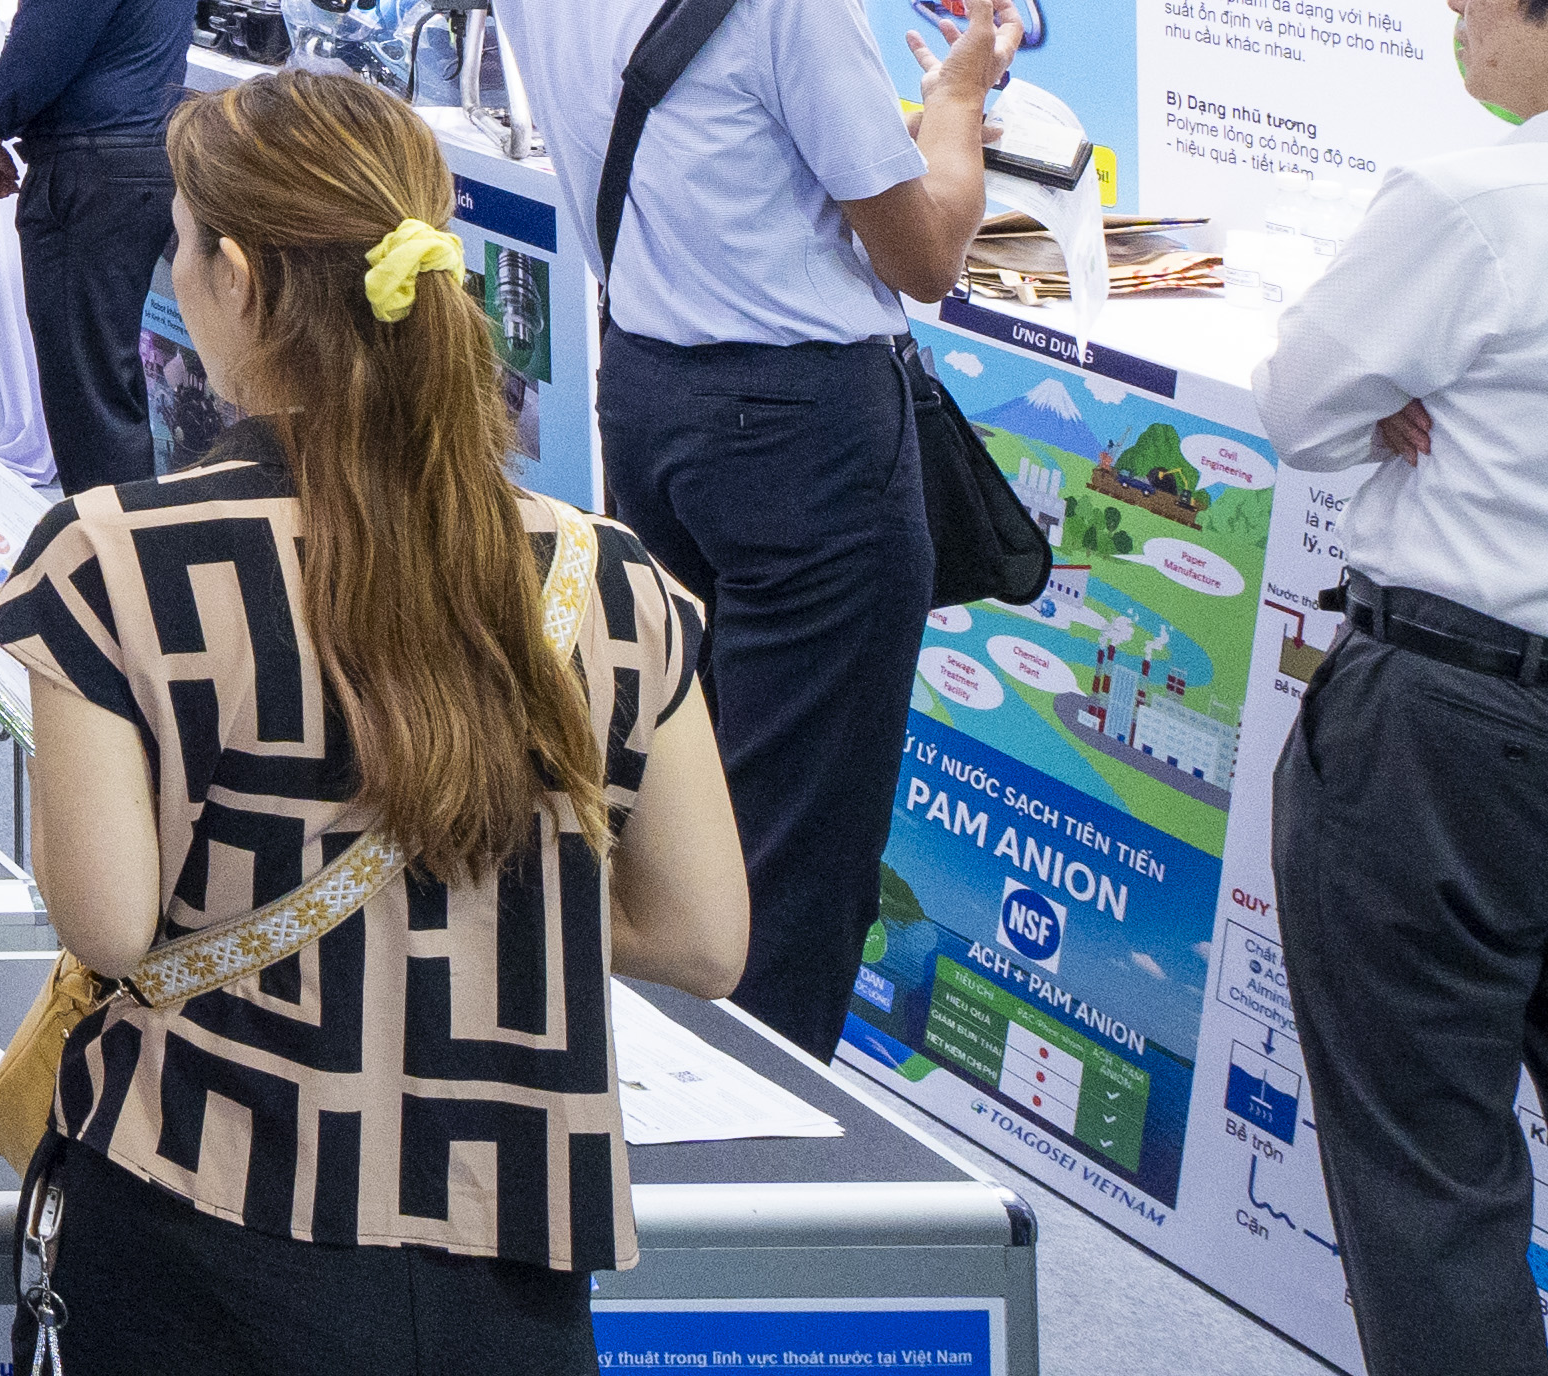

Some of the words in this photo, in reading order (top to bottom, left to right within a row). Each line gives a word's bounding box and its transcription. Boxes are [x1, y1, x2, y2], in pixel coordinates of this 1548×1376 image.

[1201, 456, 1253, 483] Engineering
[1219, 448, 1238, 462] Civil
[907, 777, 989, 848] PAM
[993, 826, 1128, 923] ANION
[916, 742, 937, 765] LÝ
[941, 754, 1000, 798] NƯỚC
[1003, 787, 1059, 828] SẠCH
[1064, 815, 1111, 855] TIÊN
[1117, 841, 1165, 883] TIẾN
[1008, 900, 1053, 946] NSF
[967, 941, 1010, 979] ACH
[1029, 975, 1072, 1013] PAM
[1074, 1002, 1146, 1055] ANION
[990, 1108, 1078, 1172] TOAGOSEI
[1082, 1165, 1166, 1226] VIETNAM
[618, 1351, 659, 1366] thuật
[664, 1353, 707, 1368] trong
[712, 1349, 742, 1365] lĩnh
[783, 1350, 824, 1365] thoát
[829, 1351, 872, 1365] nước
[877, 1352, 897, 1367] tại
[901, 1351, 932, 1366] Việt
[937, 1351, 972, 1364] Nam
